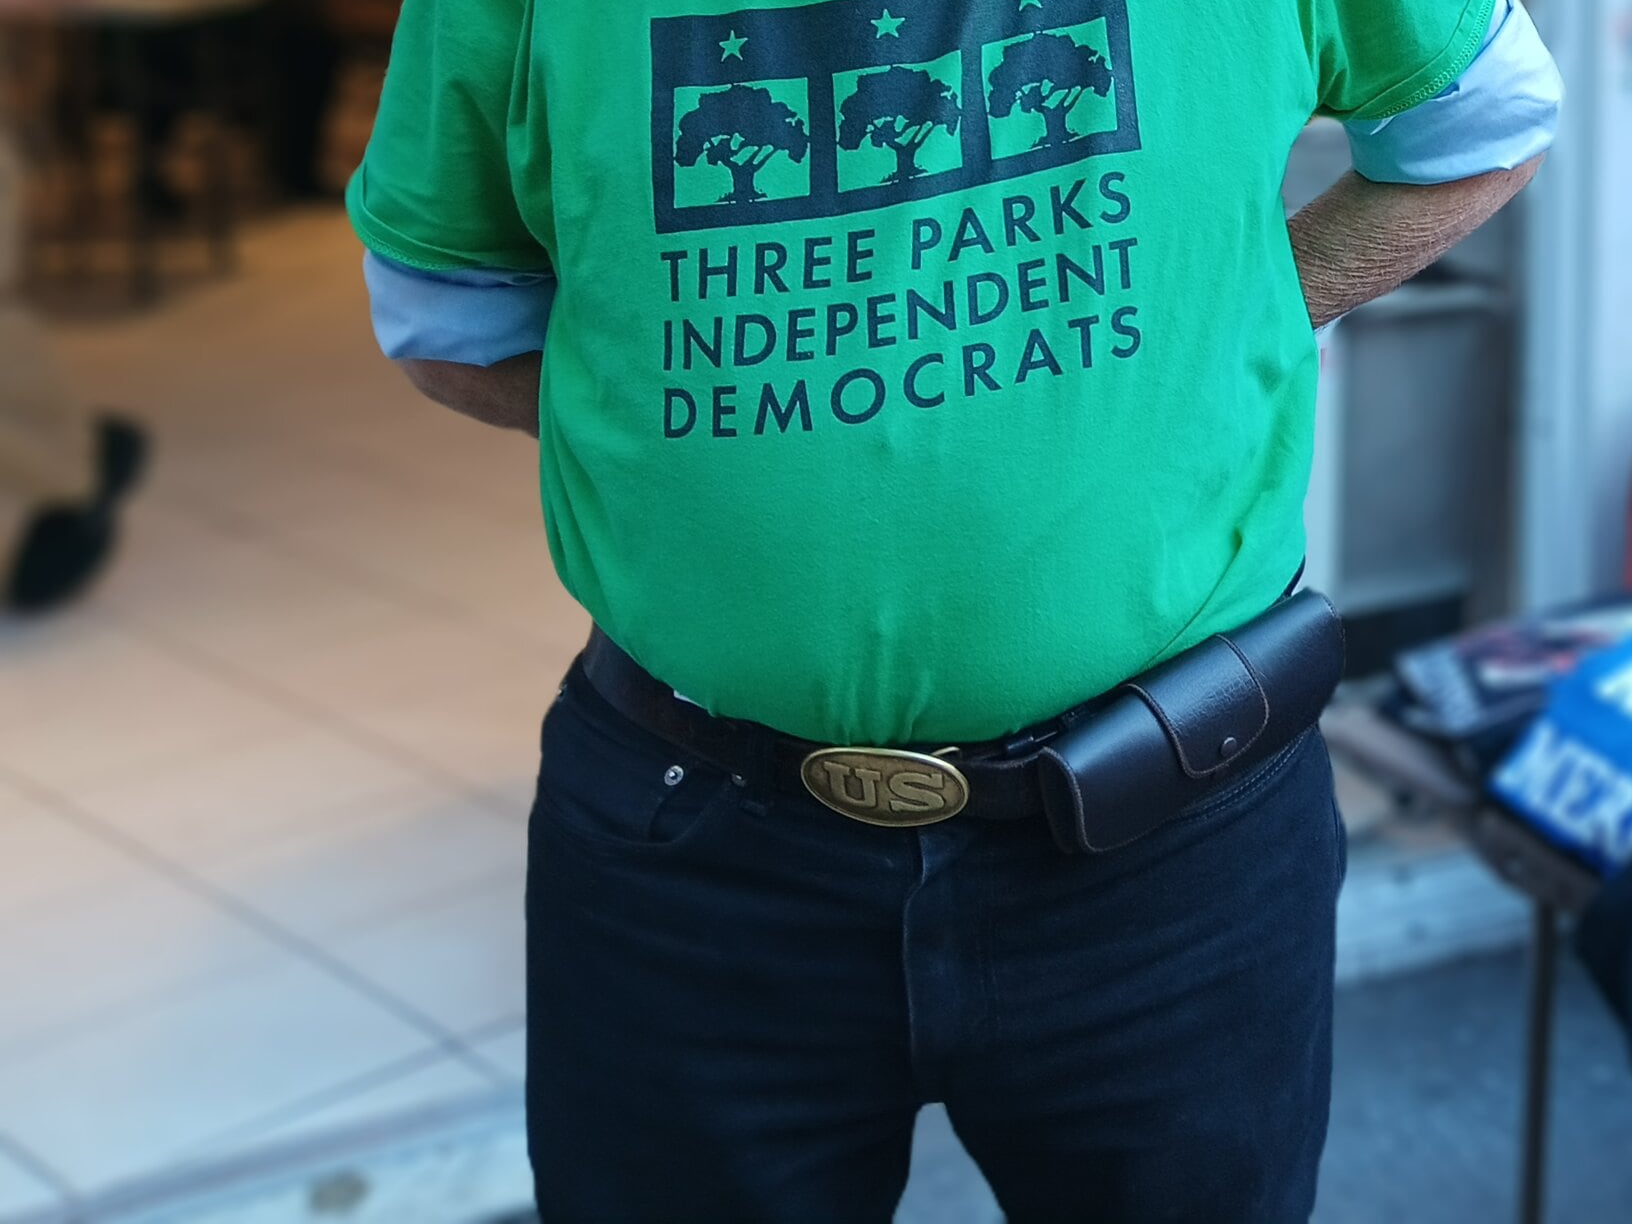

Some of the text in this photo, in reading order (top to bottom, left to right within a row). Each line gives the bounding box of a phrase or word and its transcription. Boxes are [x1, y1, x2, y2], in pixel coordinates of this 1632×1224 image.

[660, 172, 1132, 302] THREE PARKS
[662, 238, 1138, 371] INDEPENDENT
[662, 306, 1142, 439] DEMOCRATS
[823, 761, 946, 812] US
